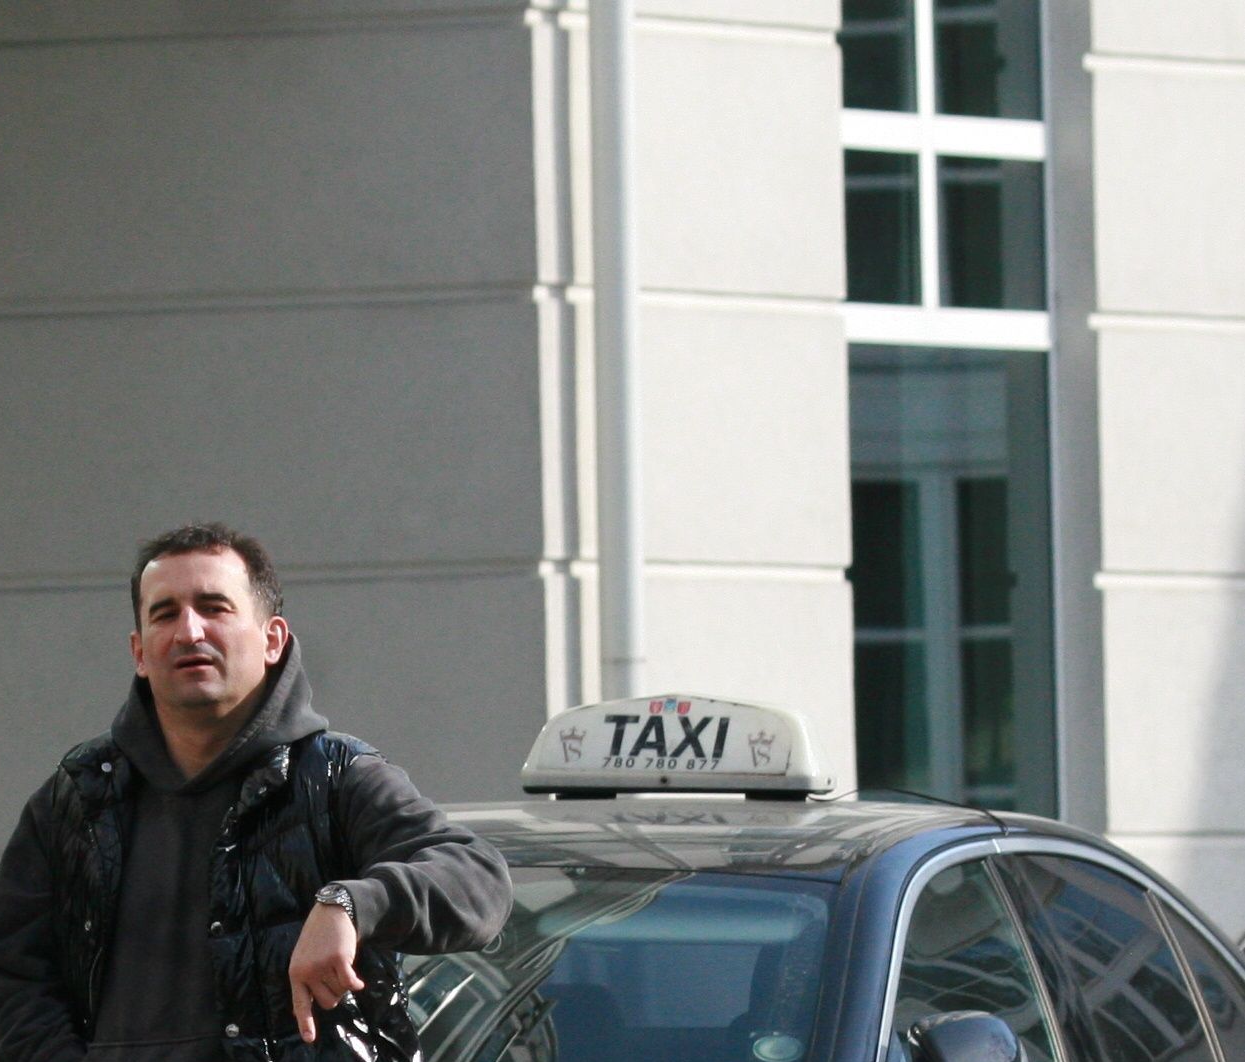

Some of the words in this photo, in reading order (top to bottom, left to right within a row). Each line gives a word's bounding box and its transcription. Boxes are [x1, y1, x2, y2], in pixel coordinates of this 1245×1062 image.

[604, 714, 730, 758] TAXI
[602, 757, 635, 769] 780
[645, 757, 678, 770] 780
[686, 758, 720, 770] 877
